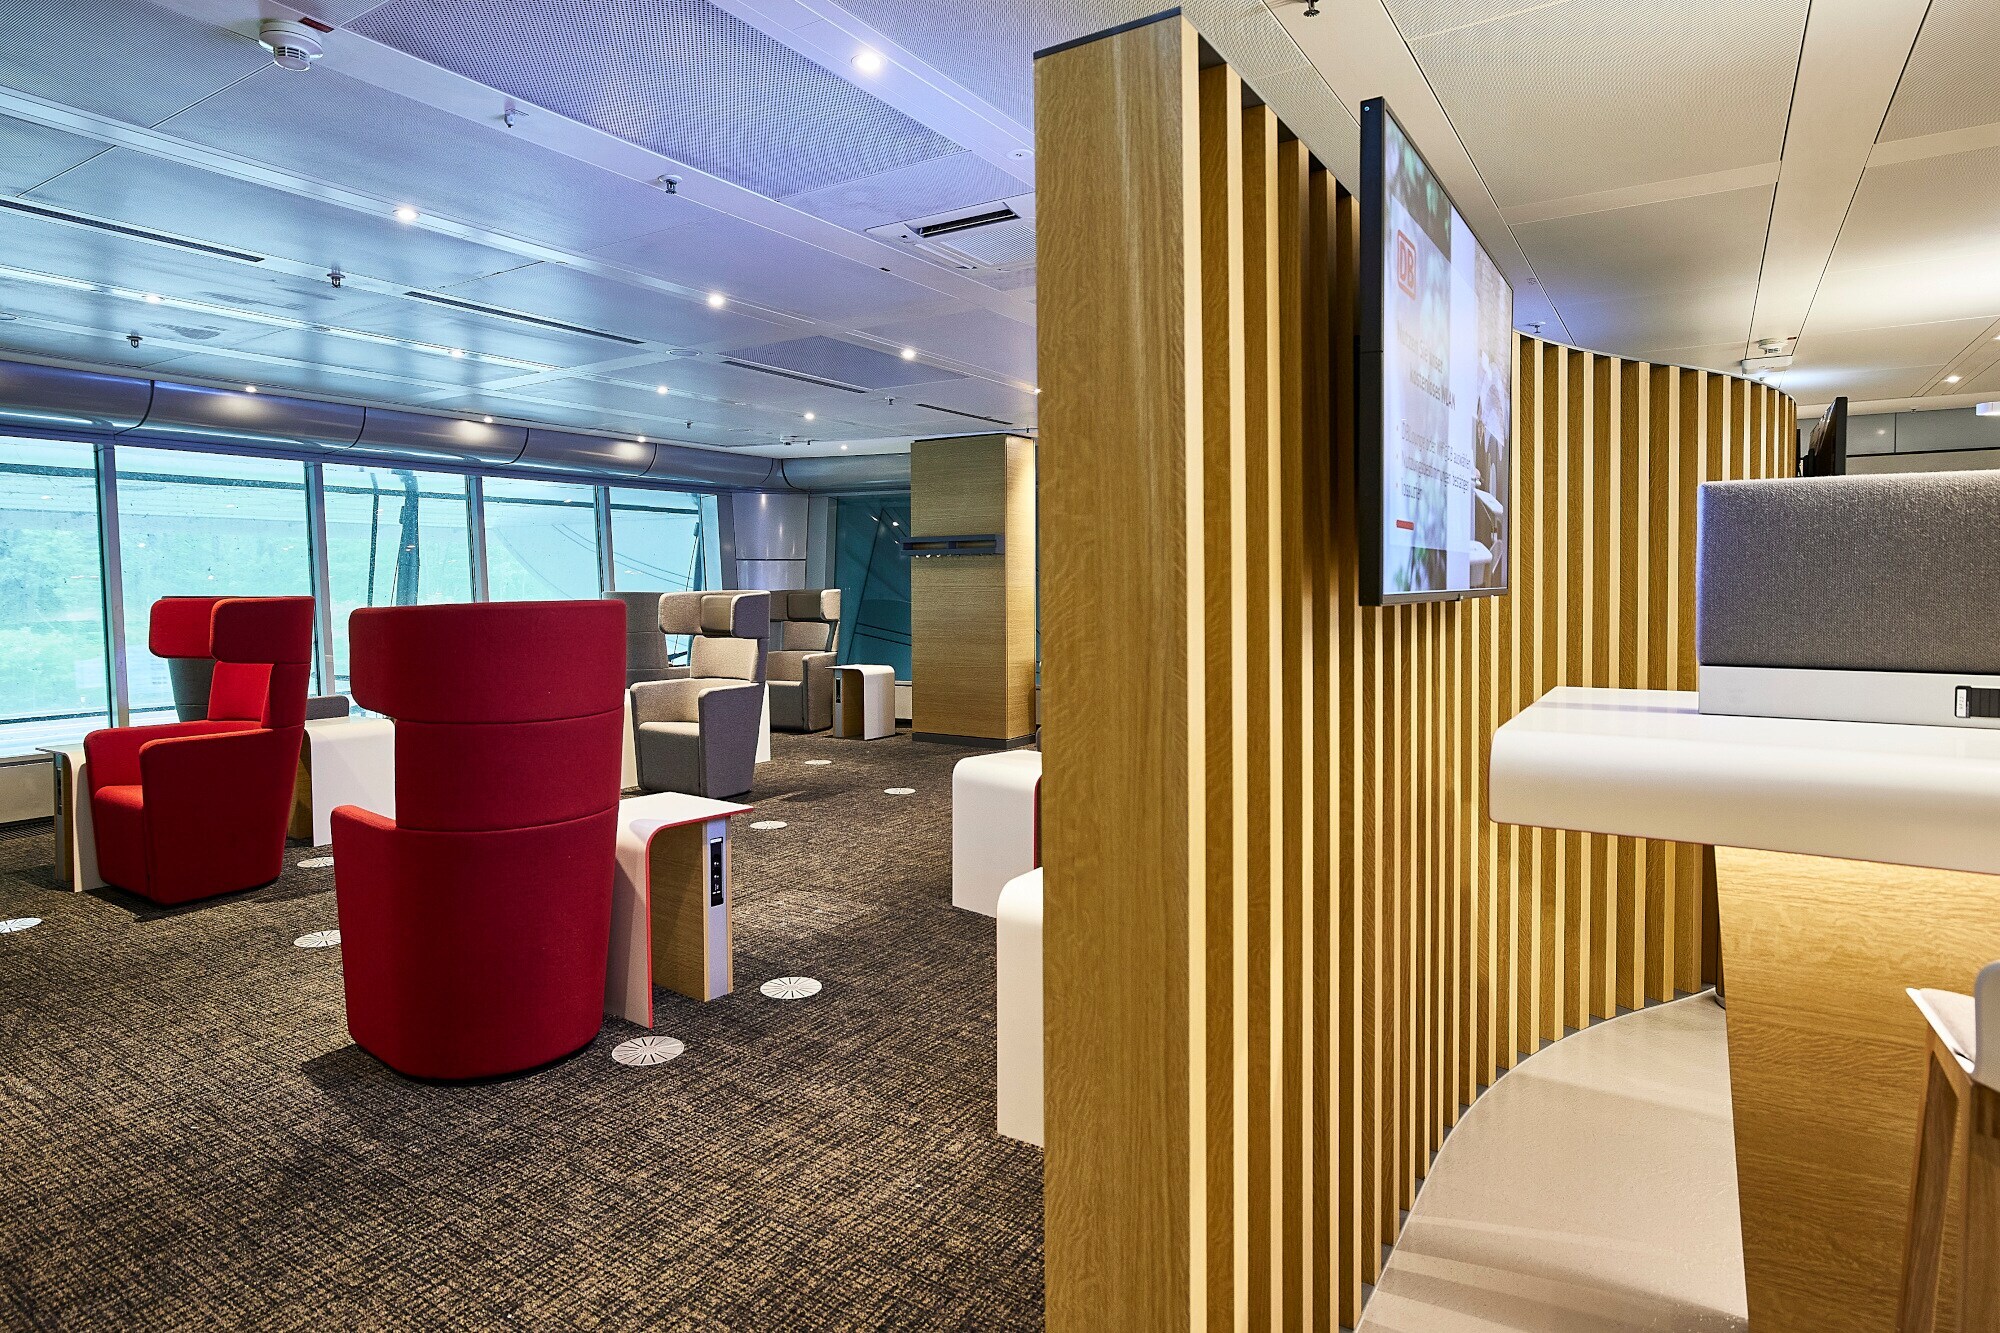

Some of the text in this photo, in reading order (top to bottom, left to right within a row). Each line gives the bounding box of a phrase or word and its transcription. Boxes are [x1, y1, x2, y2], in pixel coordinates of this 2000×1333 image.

[1399, 238, 1414, 291] DB
[1419, 336, 1428, 363] Sie
[1409, 361, 1455, 411] kostenloses WLAN
